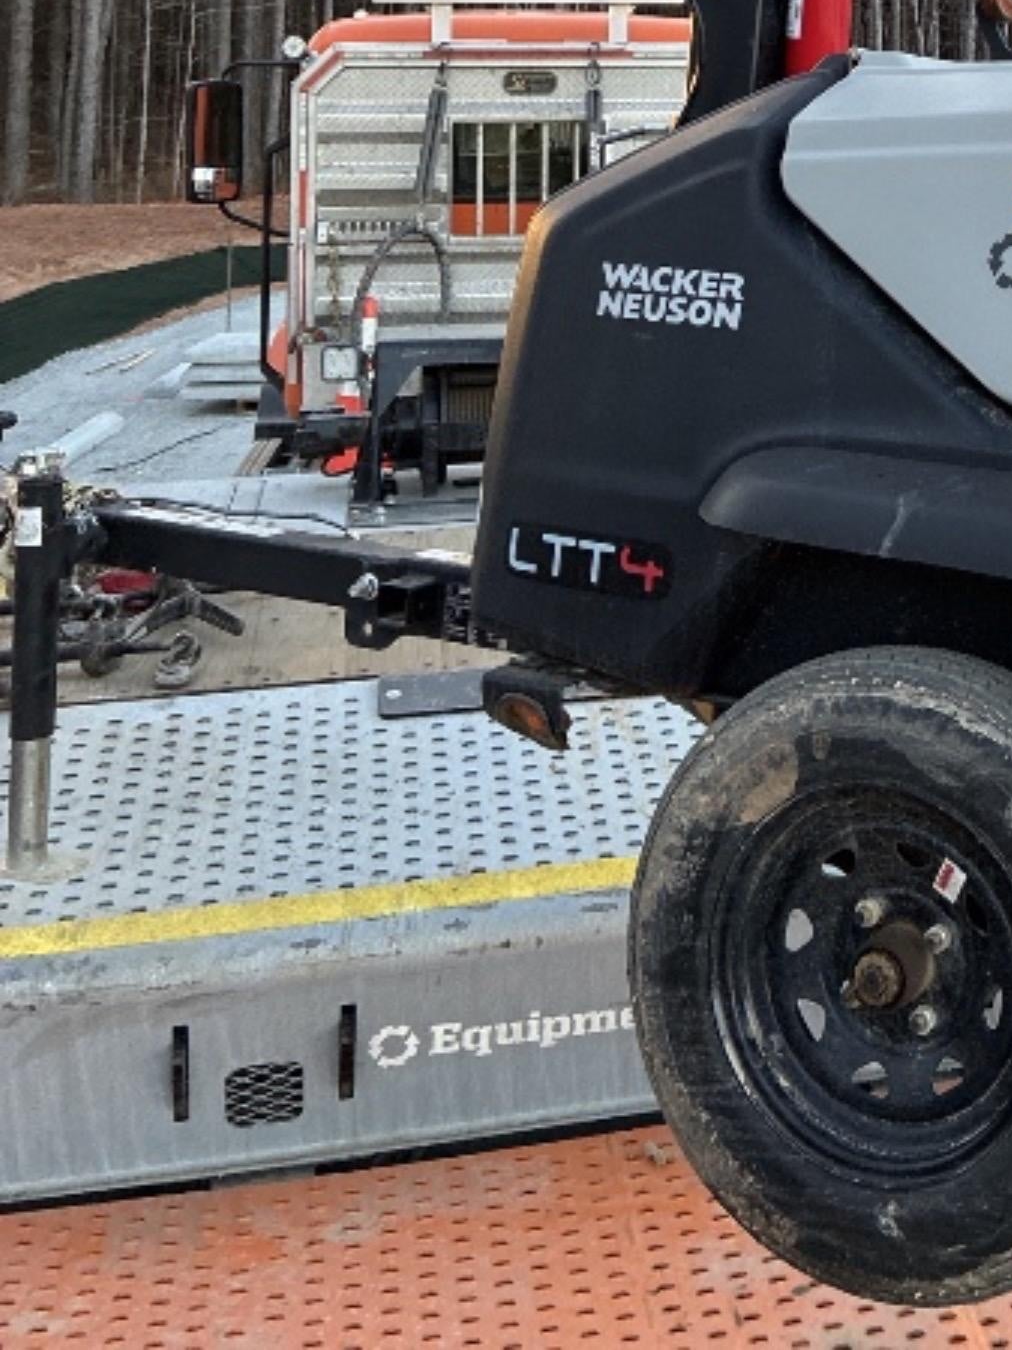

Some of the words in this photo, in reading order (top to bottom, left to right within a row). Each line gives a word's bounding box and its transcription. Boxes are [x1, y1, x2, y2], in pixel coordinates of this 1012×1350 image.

[602, 260, 744, 301] WACKER
[596, 290, 743, 331] NEUSON
[508, 527, 664, 592] LTT4
